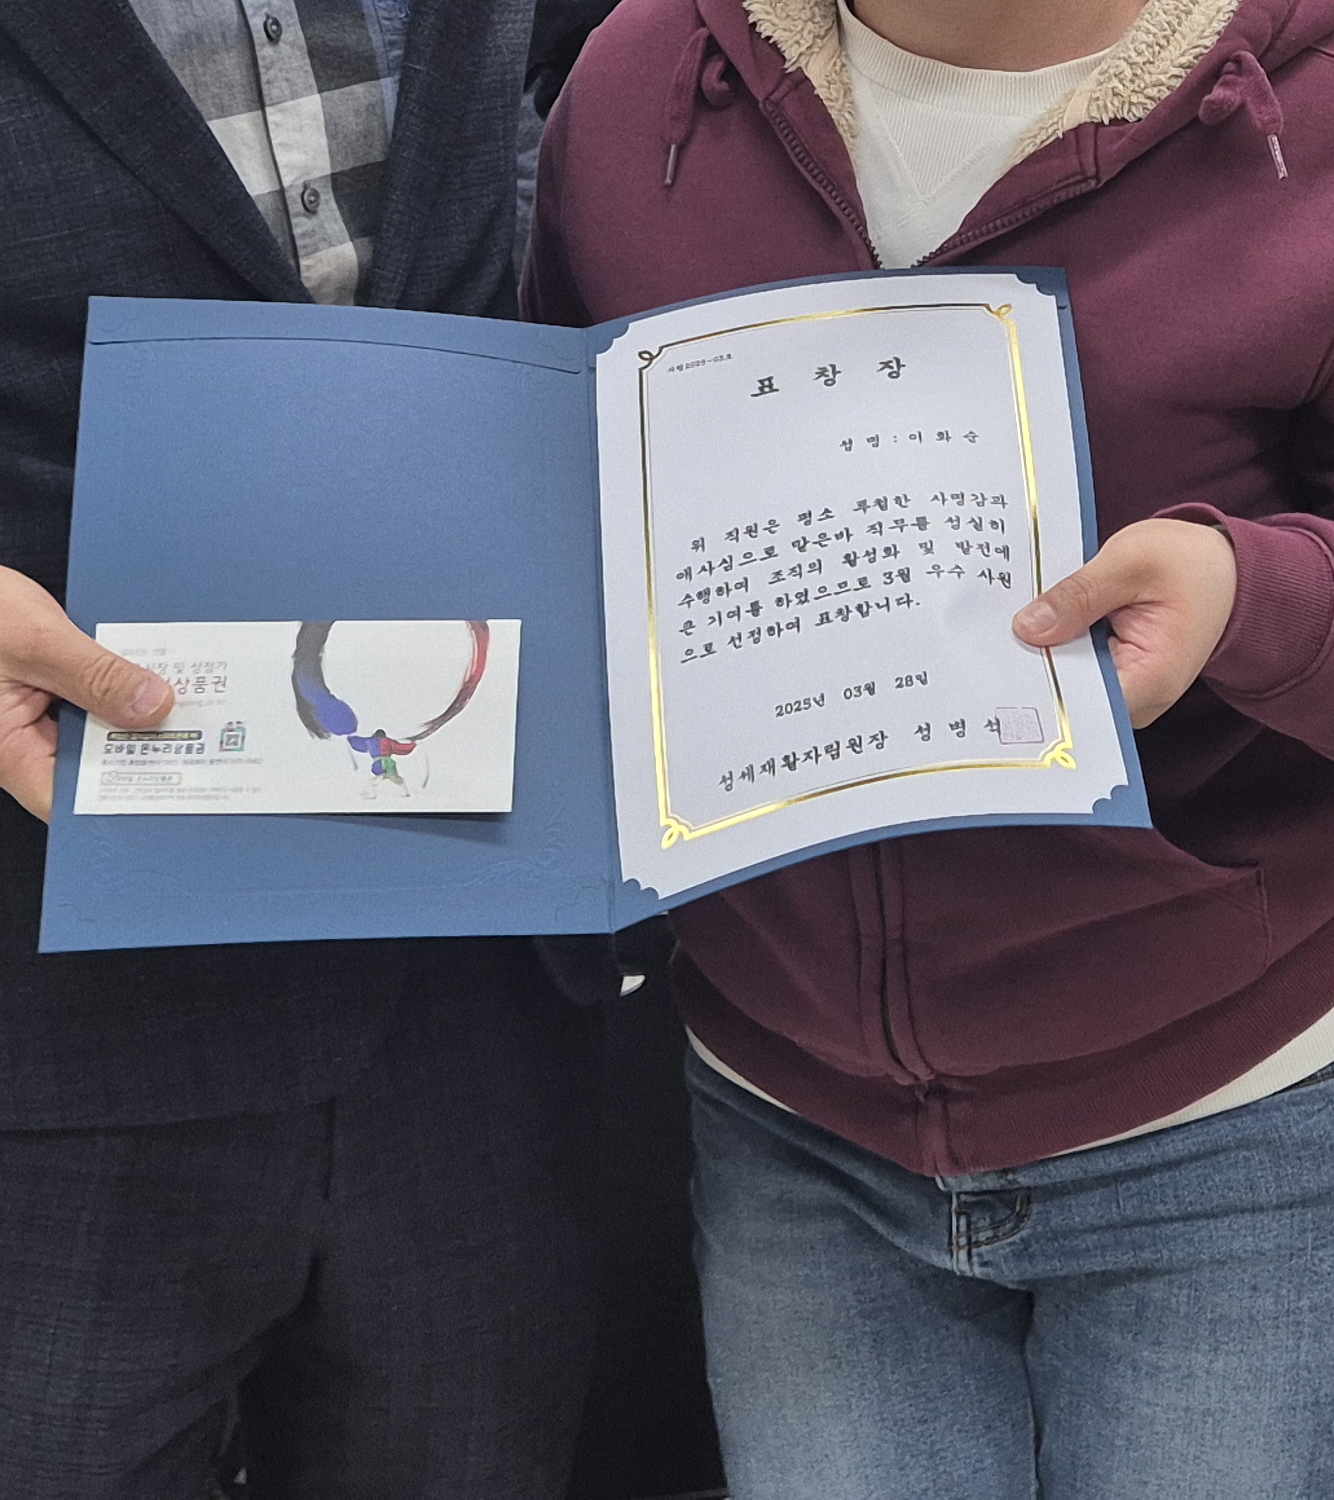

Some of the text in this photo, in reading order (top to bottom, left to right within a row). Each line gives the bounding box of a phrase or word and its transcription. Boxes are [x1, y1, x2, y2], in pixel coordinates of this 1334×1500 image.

[676, 545, 779, 583] 애사심으로
[866, 516, 931, 537] 직무를
[944, 515, 1005, 535] 성실히
[691, 491, 1009, 553] 위 직원은 평소 투철한 사명감과
[677, 539, 1010, 609] 수행하여 조직의 활성화 및 발전에
[678, 564, 1012, 636] 큰 기여를 하였으므로 3월 우수 사원
[680, 592, 921, 664] 으로 선정하여 표창합니다.
[774, 671, 929, 718] 2025년 03월 28일
[718, 730, 889, 792] 성세재활자립원장
